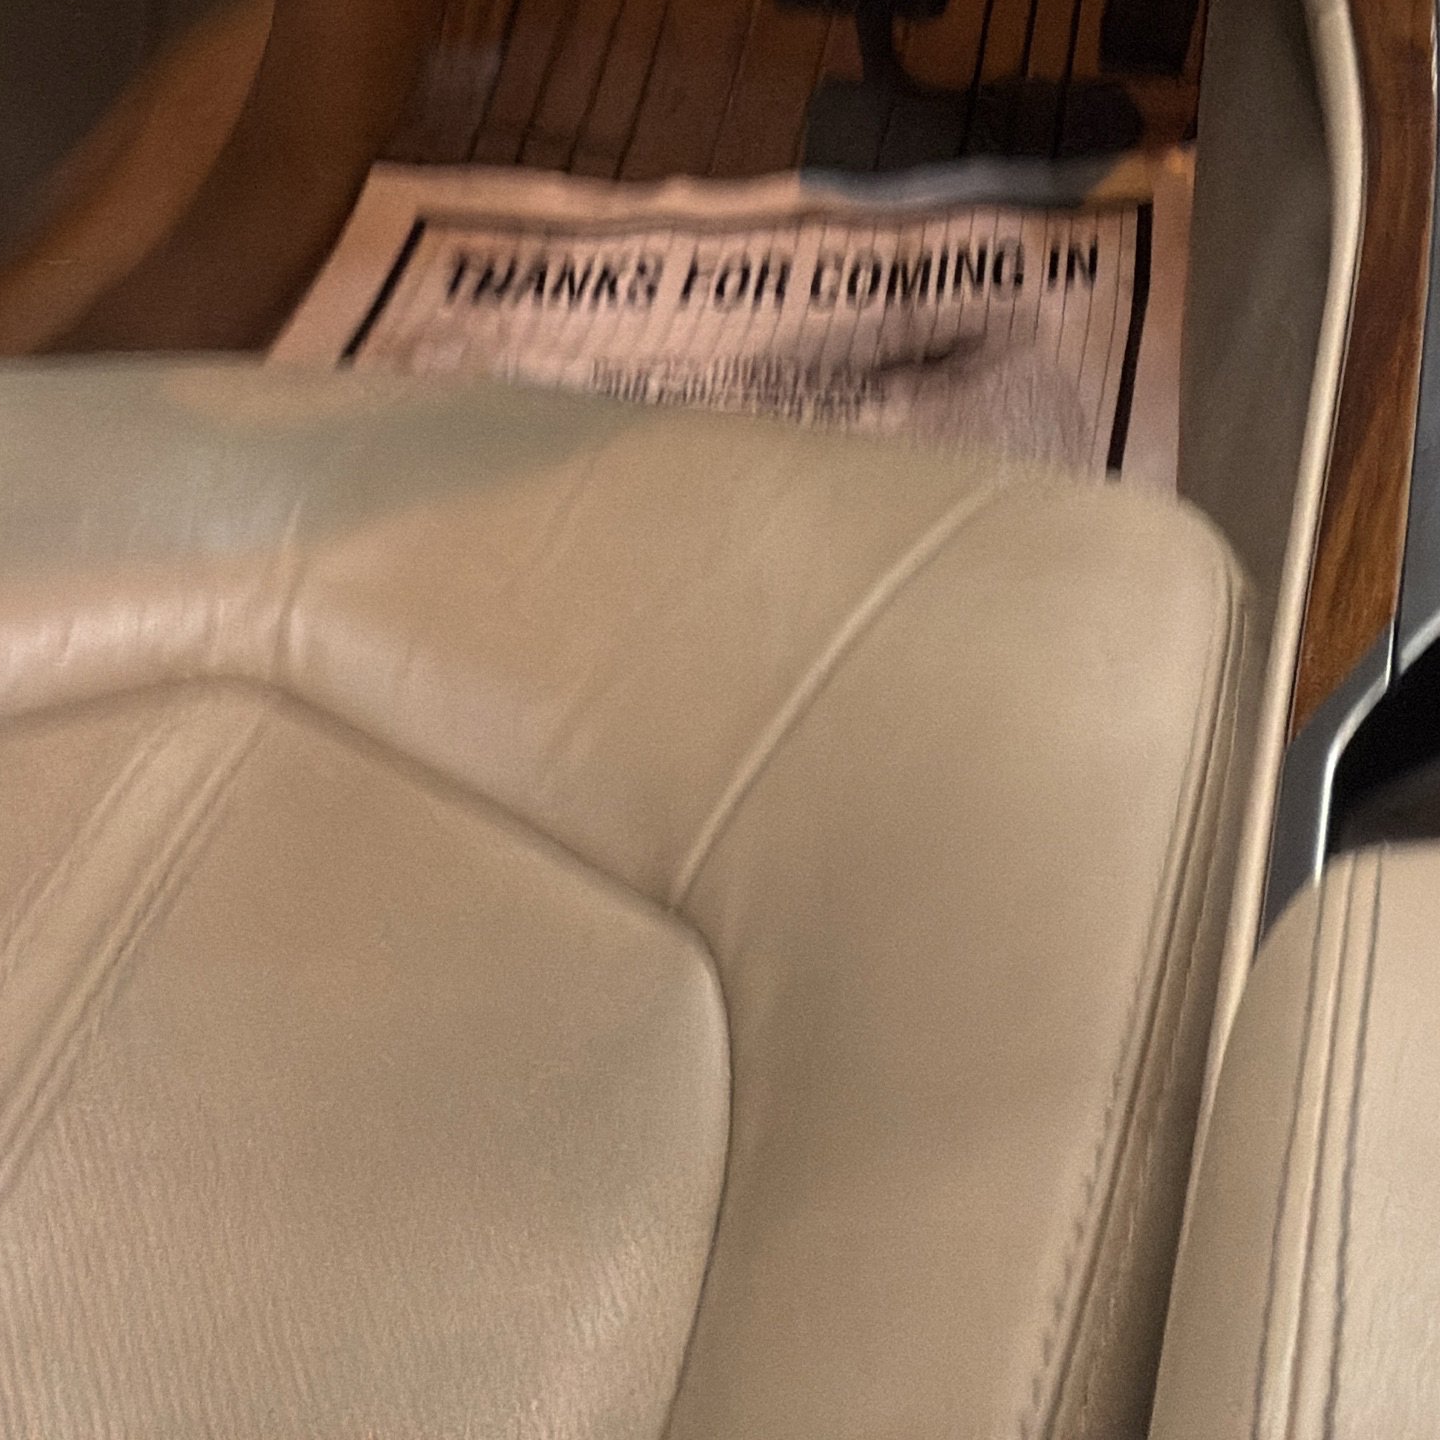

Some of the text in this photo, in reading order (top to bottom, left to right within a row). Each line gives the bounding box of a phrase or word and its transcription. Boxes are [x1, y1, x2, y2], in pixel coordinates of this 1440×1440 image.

[446, 233, 1099, 310] THANKS FOR COMING IN
